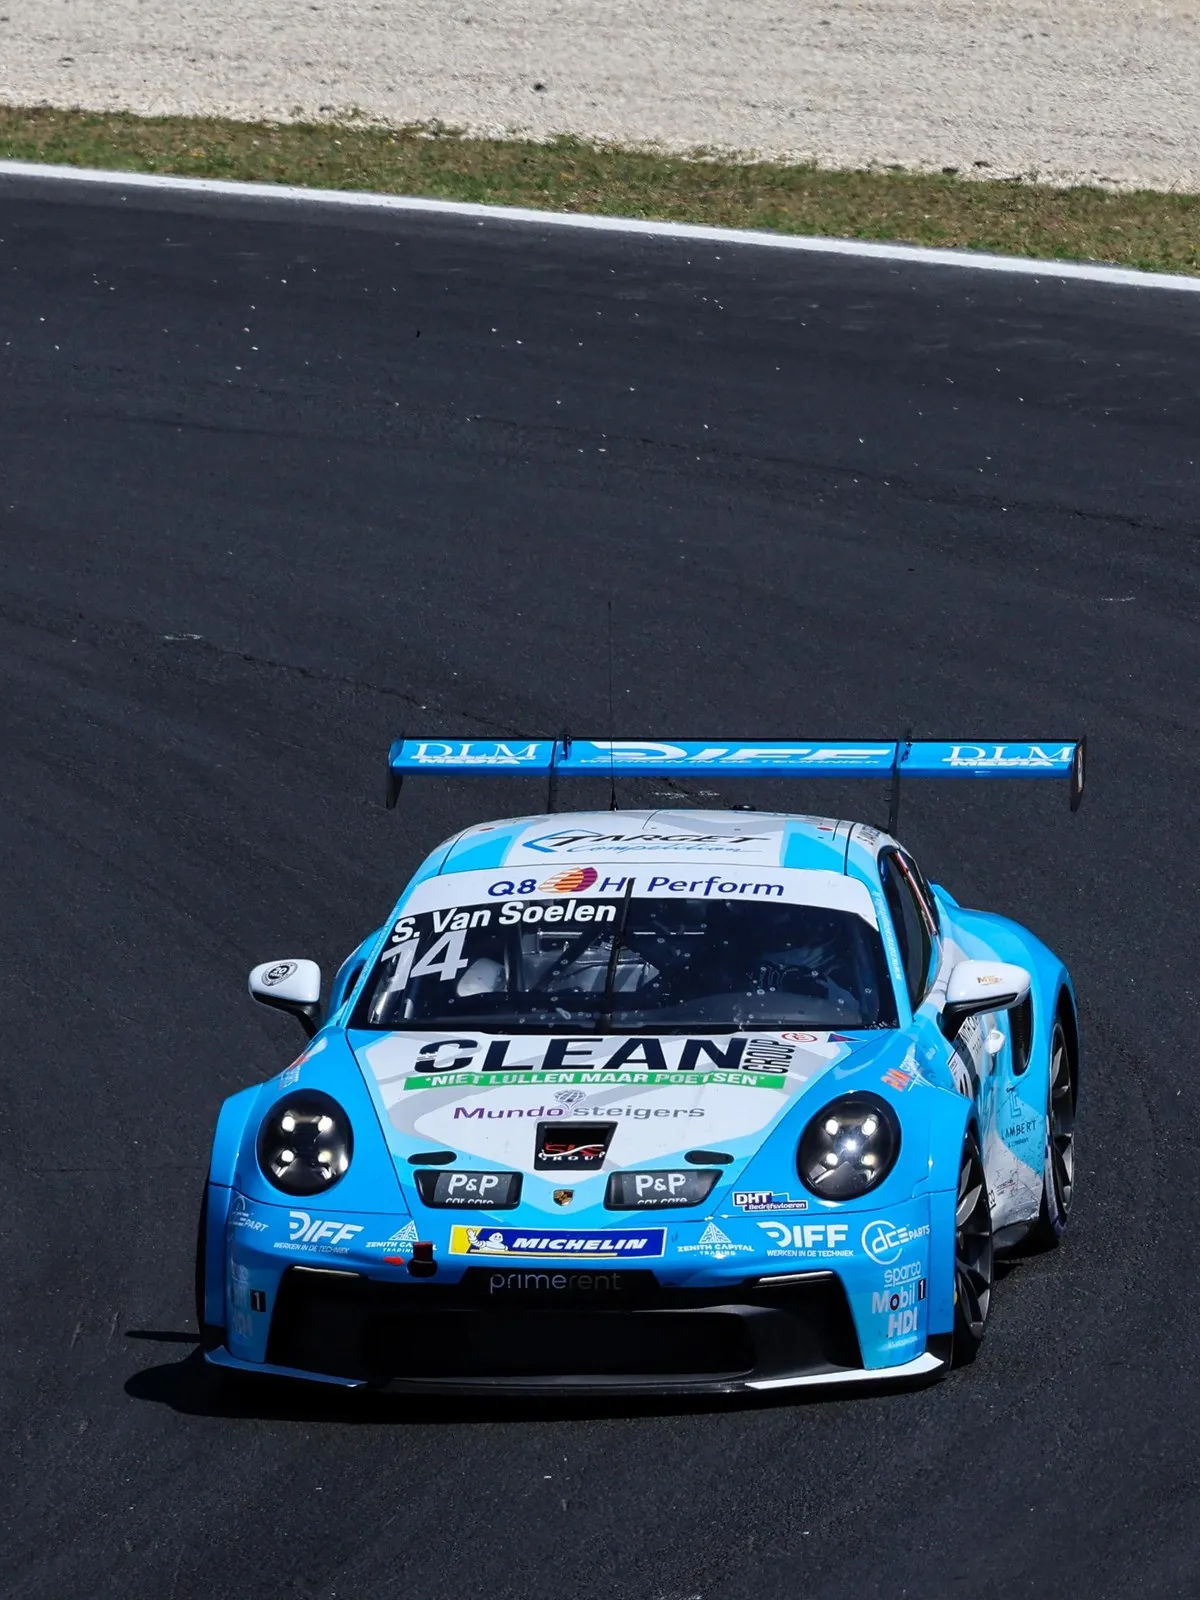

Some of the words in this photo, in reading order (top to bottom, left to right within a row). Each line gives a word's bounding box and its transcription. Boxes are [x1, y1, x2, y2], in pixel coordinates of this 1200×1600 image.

[411, 743, 542, 760] DLM
[590, 741, 891, 761] DIFF
[942, 745, 1076, 761] DLM
[549, 833, 771, 847] TARGET
[487, 879, 536, 898] Q8
[647, 875, 785, 897] Perform
[392, 917, 420, 943] S.
[432, 907, 492, 933] Van
[498, 899, 617, 926] Soelen
[381, 929, 469, 994] 14
[413, 1037, 748, 1074] CLEAN
[742, 1038, 797, 1074] GROUP
[489, 1073, 573, 1085] LULLEN
[580, 1072, 649, 1084] MAAR
[1001, 1120, 1037, 1140] LAMBERT
[448, 1173, 499, 1197] P&P
[635, 1173, 687, 1197] P&P
[736, 1193, 770, 1205] DHT
[749, 1202, 806, 1211] Bedrijfsvloeren
[289, 1210, 364, 1245] DIFF
[756, 1221, 849, 1248] DIFF
[909, 1225, 930, 1240] PARTS
[512, 1237, 649, 1251] MICHELIN
[677, 1243, 711, 1252] ZENITH
[713, 1243, 755, 1252] CAPITAL
[817, 1250, 854, 1258] TECHNIEK
[489, 1272, 622, 1294] primerent
[884, 1261, 921, 1287] sparco
[871, 1282, 916, 1314] Mobil
[918, 1279, 925, 1300] 1
[887, 1306, 918, 1338] HDI
